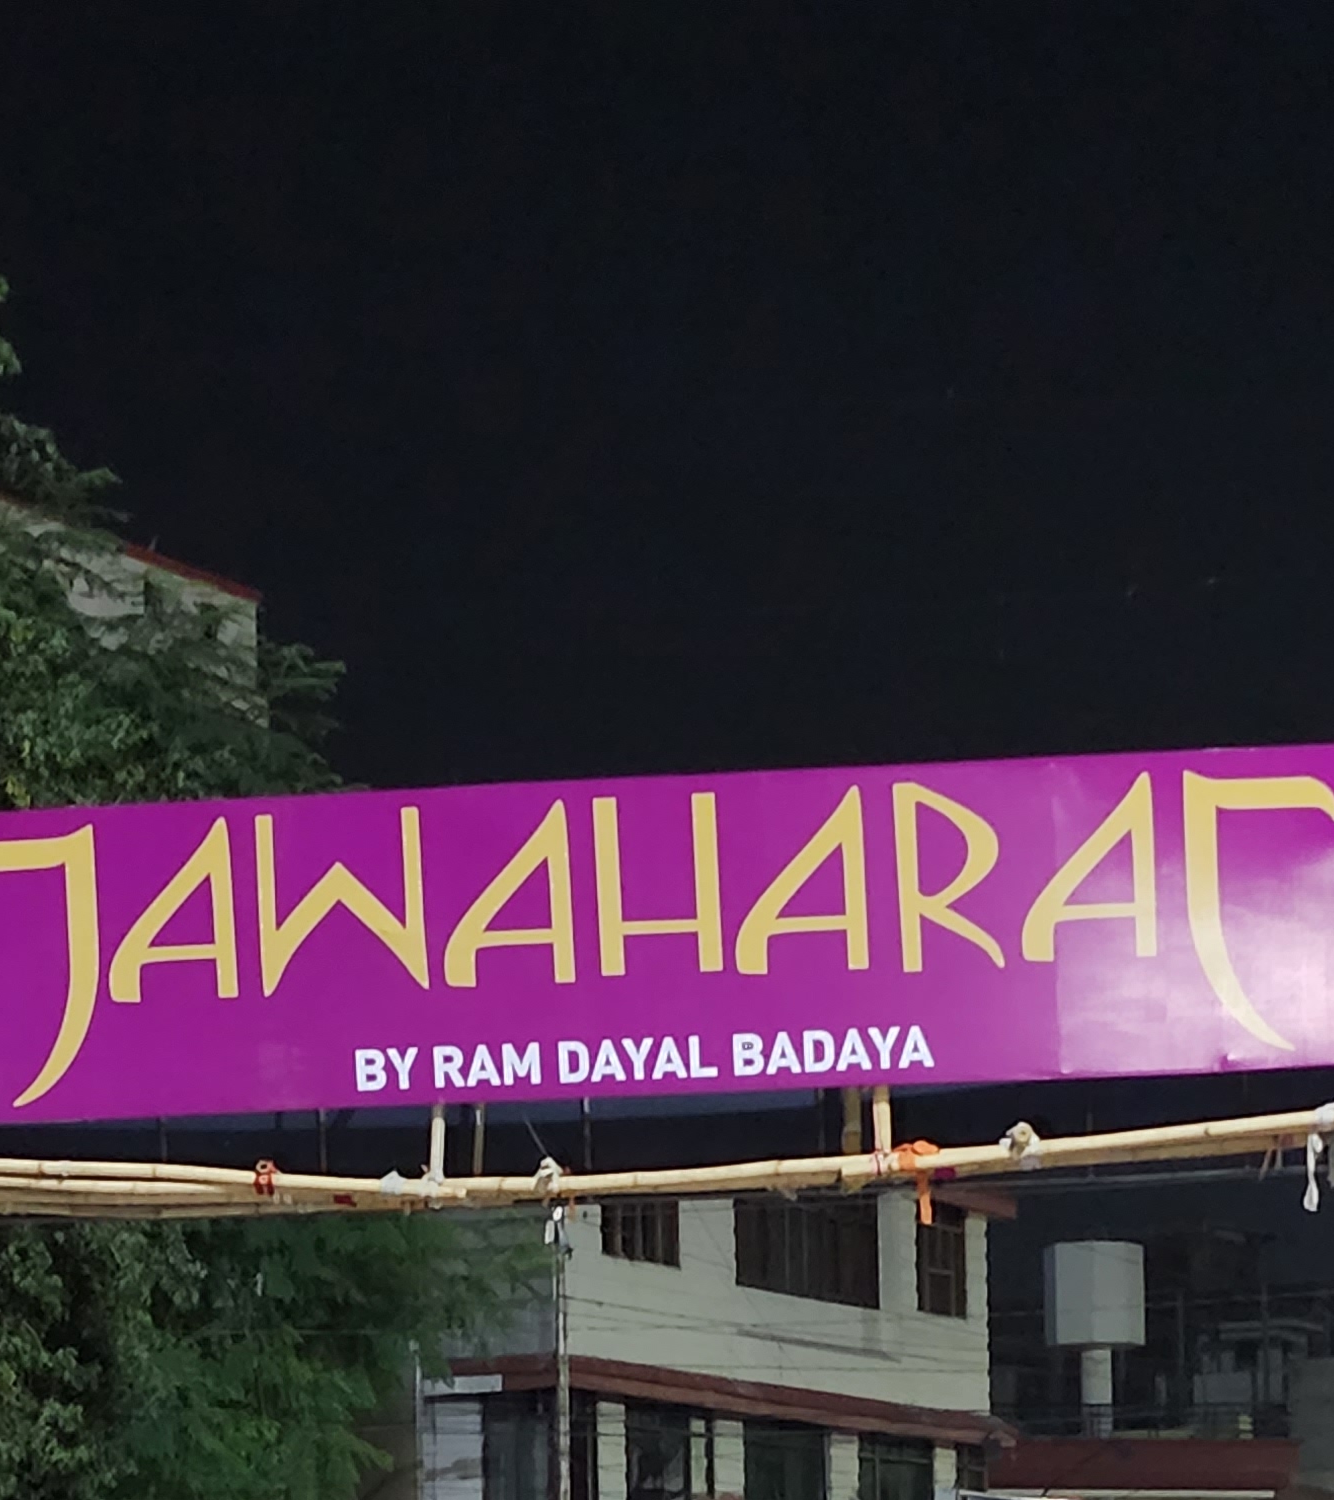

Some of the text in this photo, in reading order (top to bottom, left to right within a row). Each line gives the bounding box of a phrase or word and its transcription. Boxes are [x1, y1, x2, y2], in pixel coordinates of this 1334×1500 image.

[354, 1024, 935, 1092] BY RAM DAYAL BADAYA
